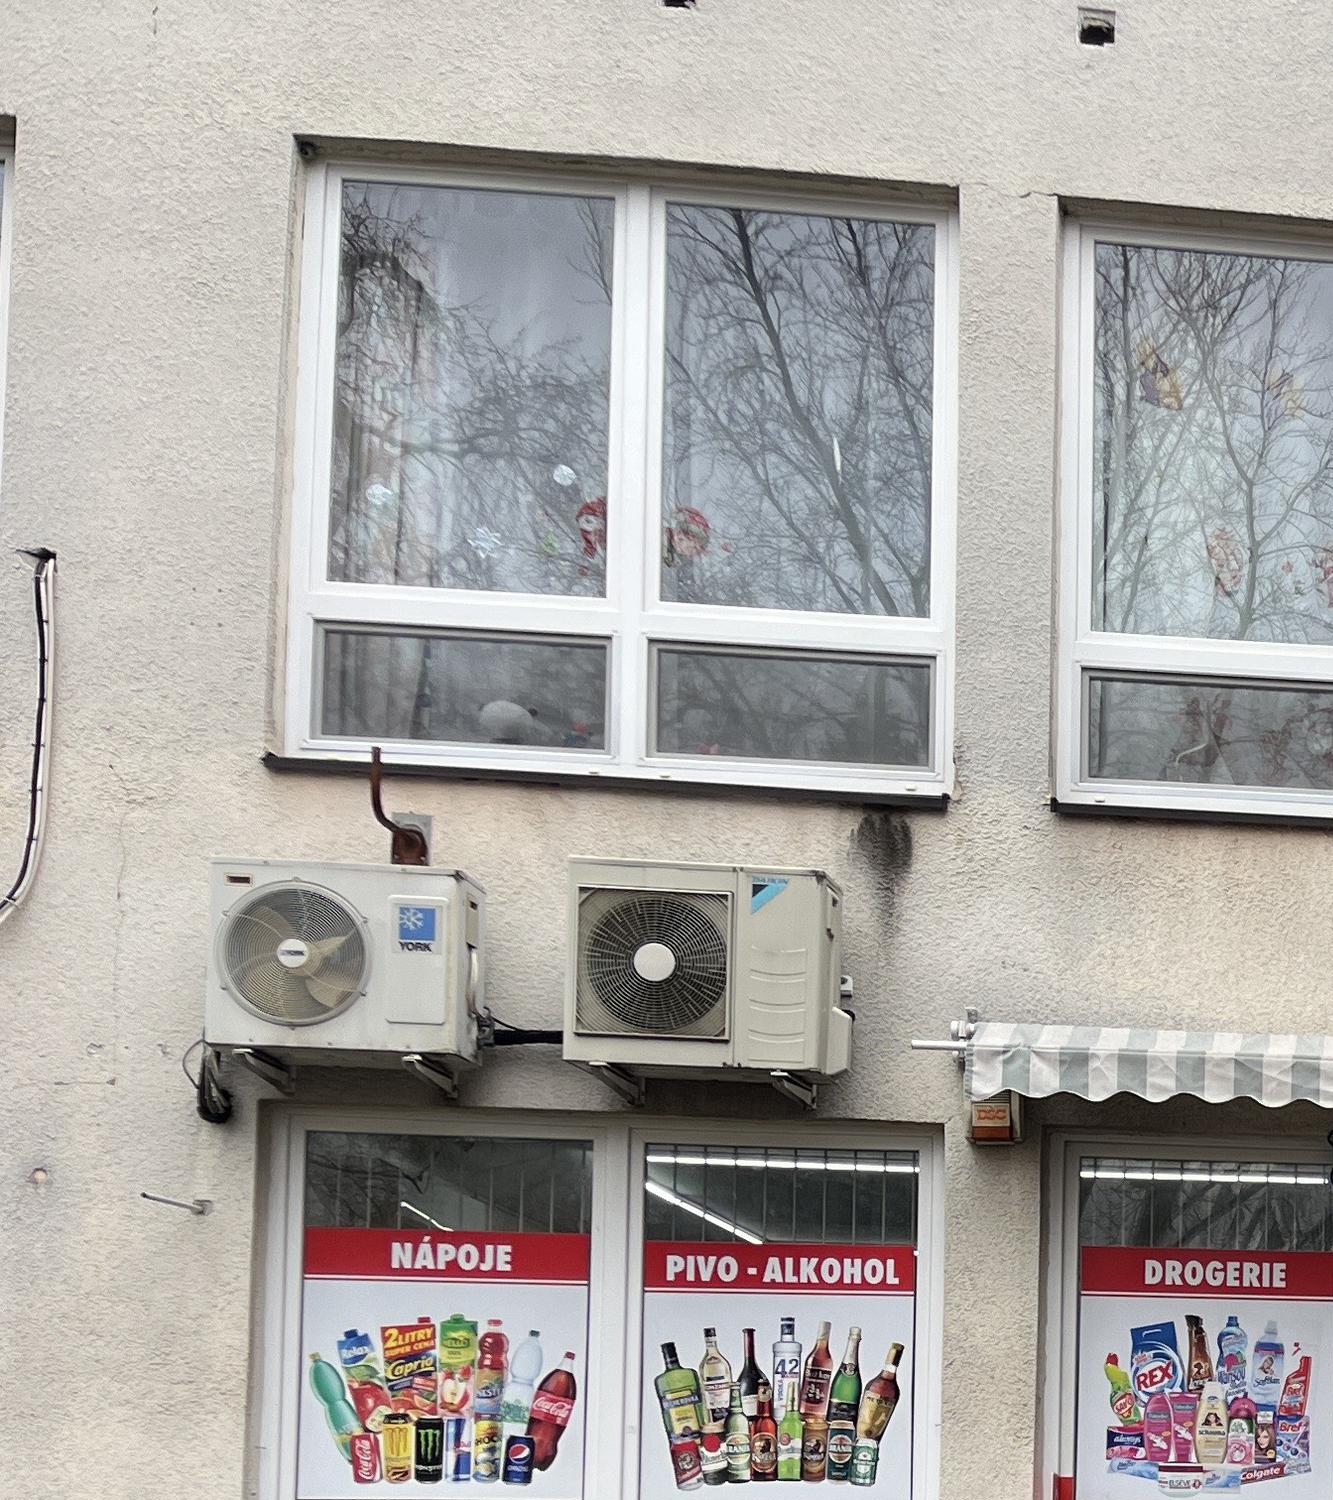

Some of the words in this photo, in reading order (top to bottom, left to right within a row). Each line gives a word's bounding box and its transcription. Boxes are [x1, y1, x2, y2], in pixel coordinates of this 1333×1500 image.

[398, 941, 433, 953] YORK
[391, 1235, 513, 1272] NÁPOJE
[666, 1254, 739, 1283] PIVO
[762, 1256, 900, 1285] ALKOHOL
[1144, 1259, 1287, 1288] DROGERIE
[1136, 1360, 1174, 1391] REX
[1240, 1466, 1281, 1480] Colgate
